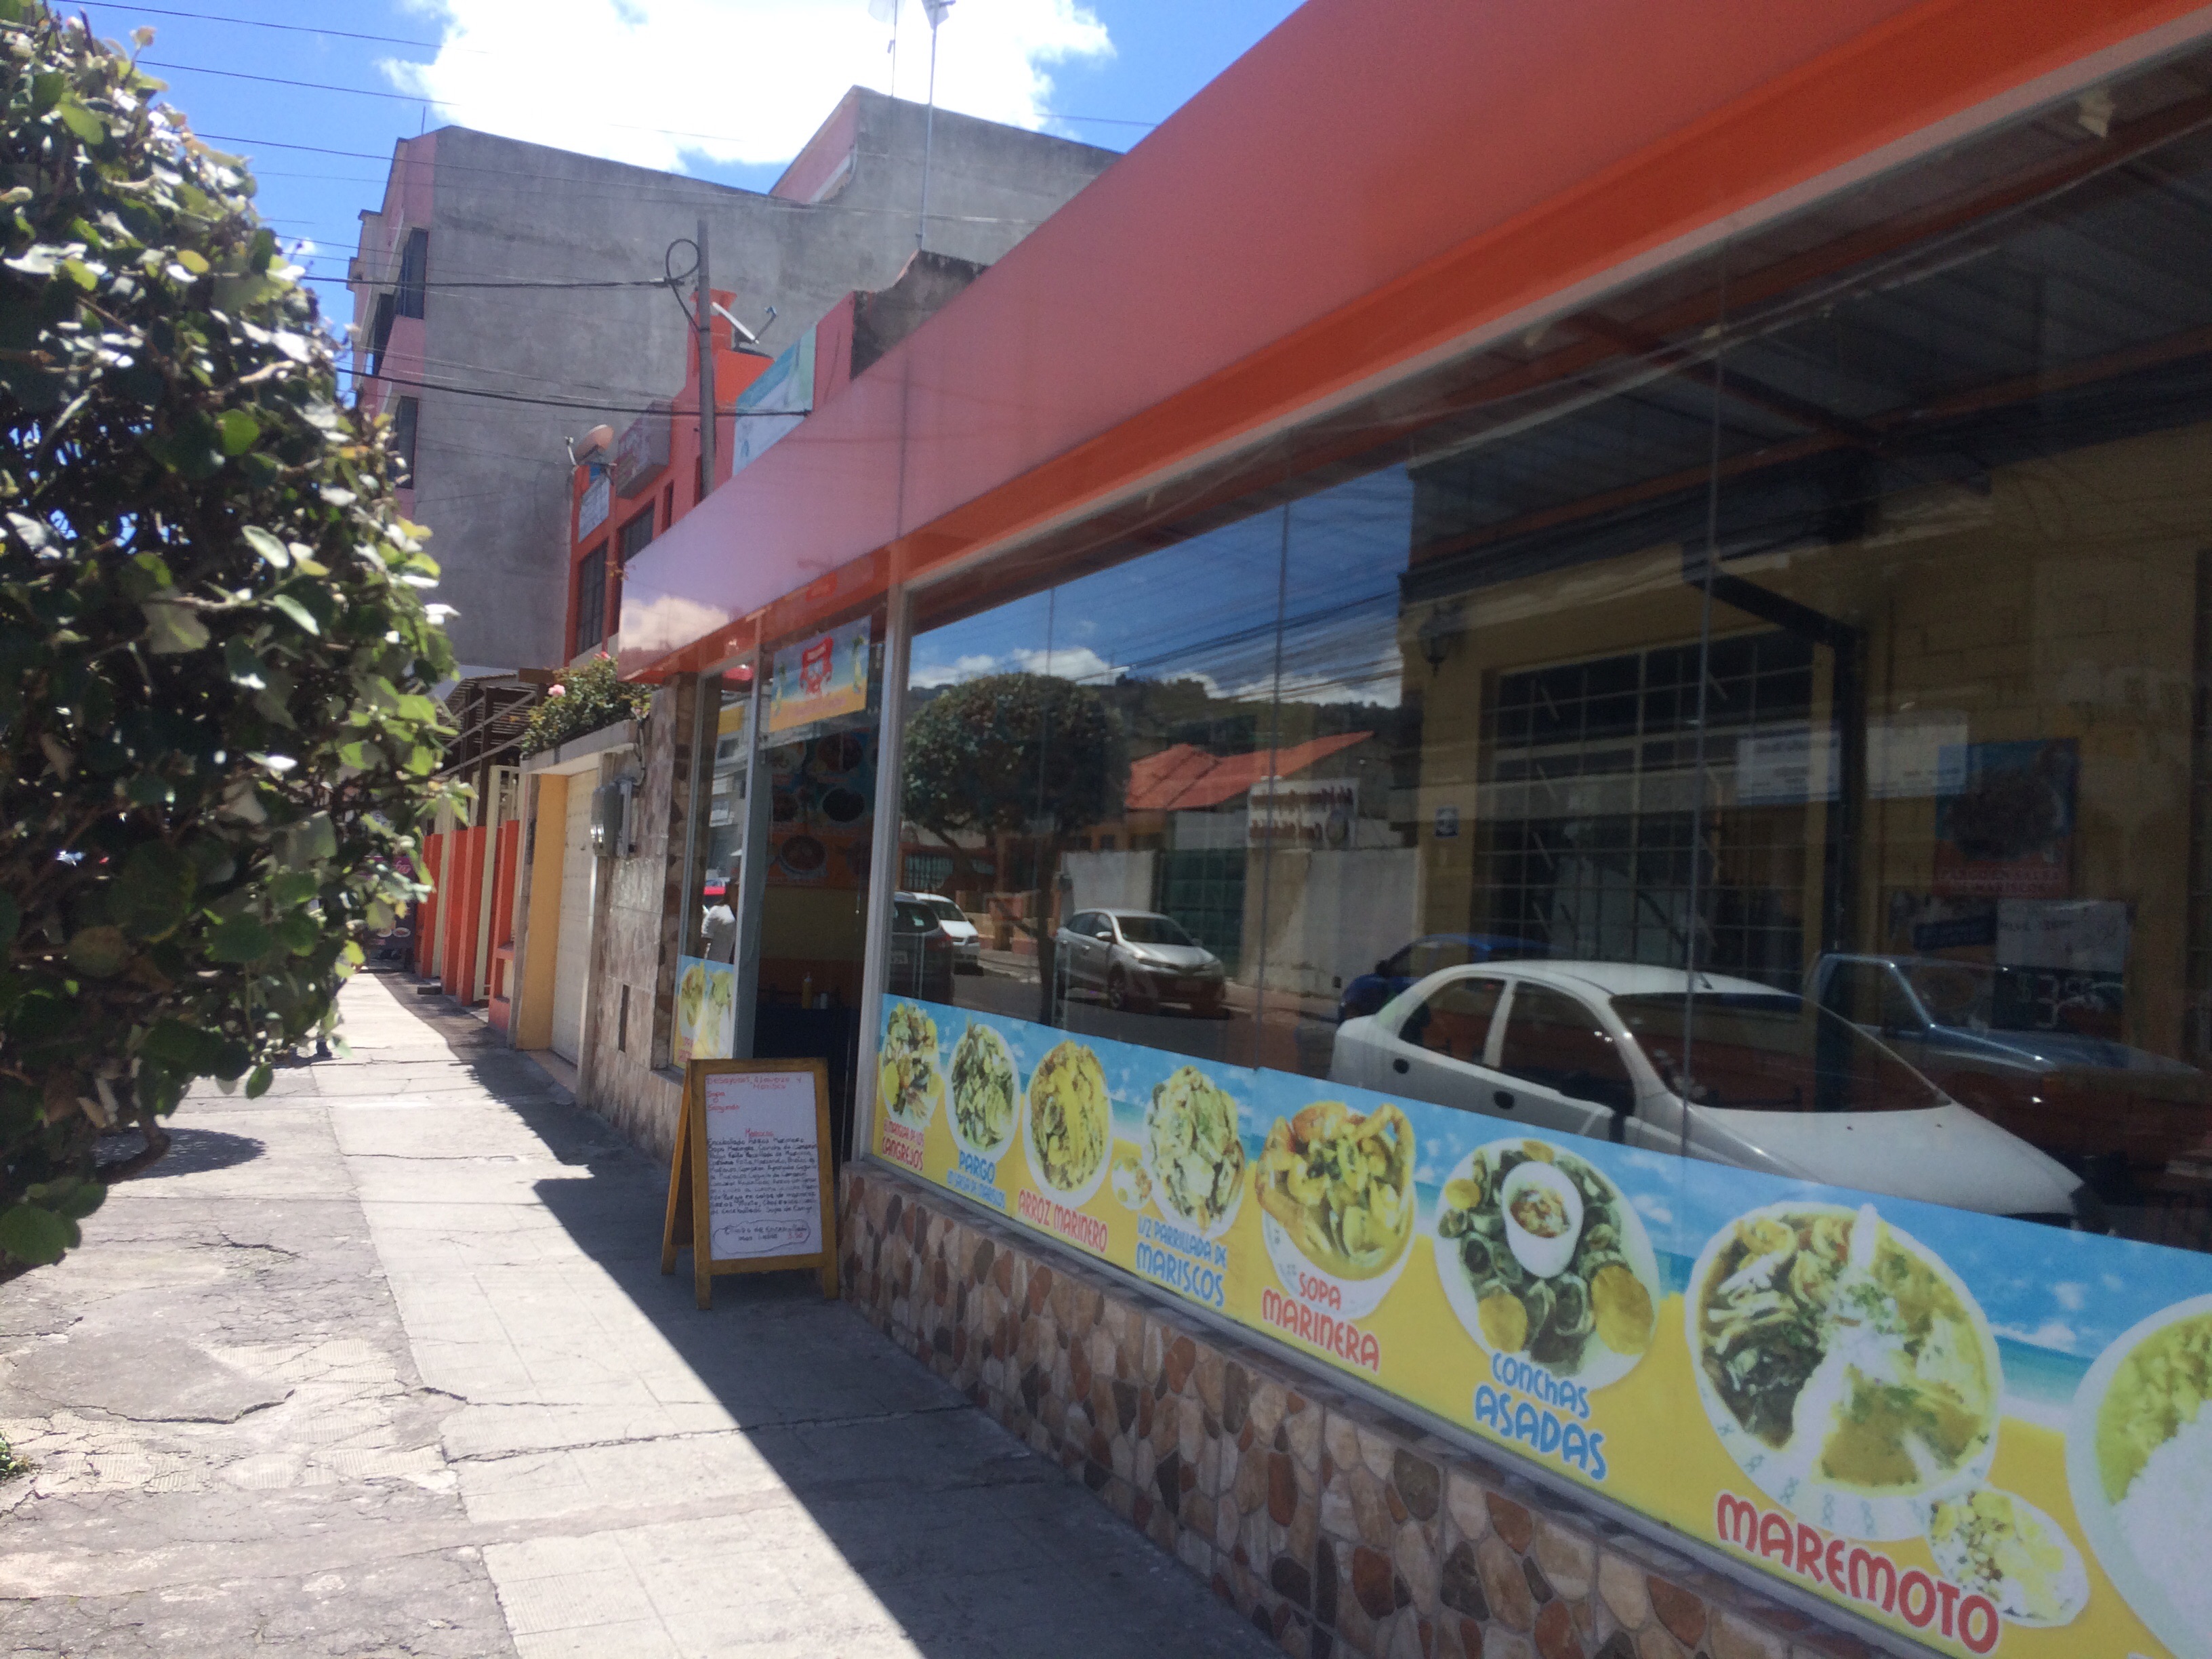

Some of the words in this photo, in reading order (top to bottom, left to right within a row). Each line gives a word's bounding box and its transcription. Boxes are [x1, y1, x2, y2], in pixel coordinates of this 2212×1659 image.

[958, 1149, 996, 1185] PARGO
[1018, 1188, 1052, 1227] ARROZ
[1053, 1203, 1109, 1254] MARINERO
[1135, 1241, 1225, 1308] MARISCOS
[1298, 1271, 1343, 1311] SOPA
[1261, 1288, 1380, 1373] MARINERA
[1492, 1352, 1591, 1420] CONCHAS
[1475, 1384, 1607, 1481] ASADAS
[1717, 1493, 1999, 1654] MAREMOTO
